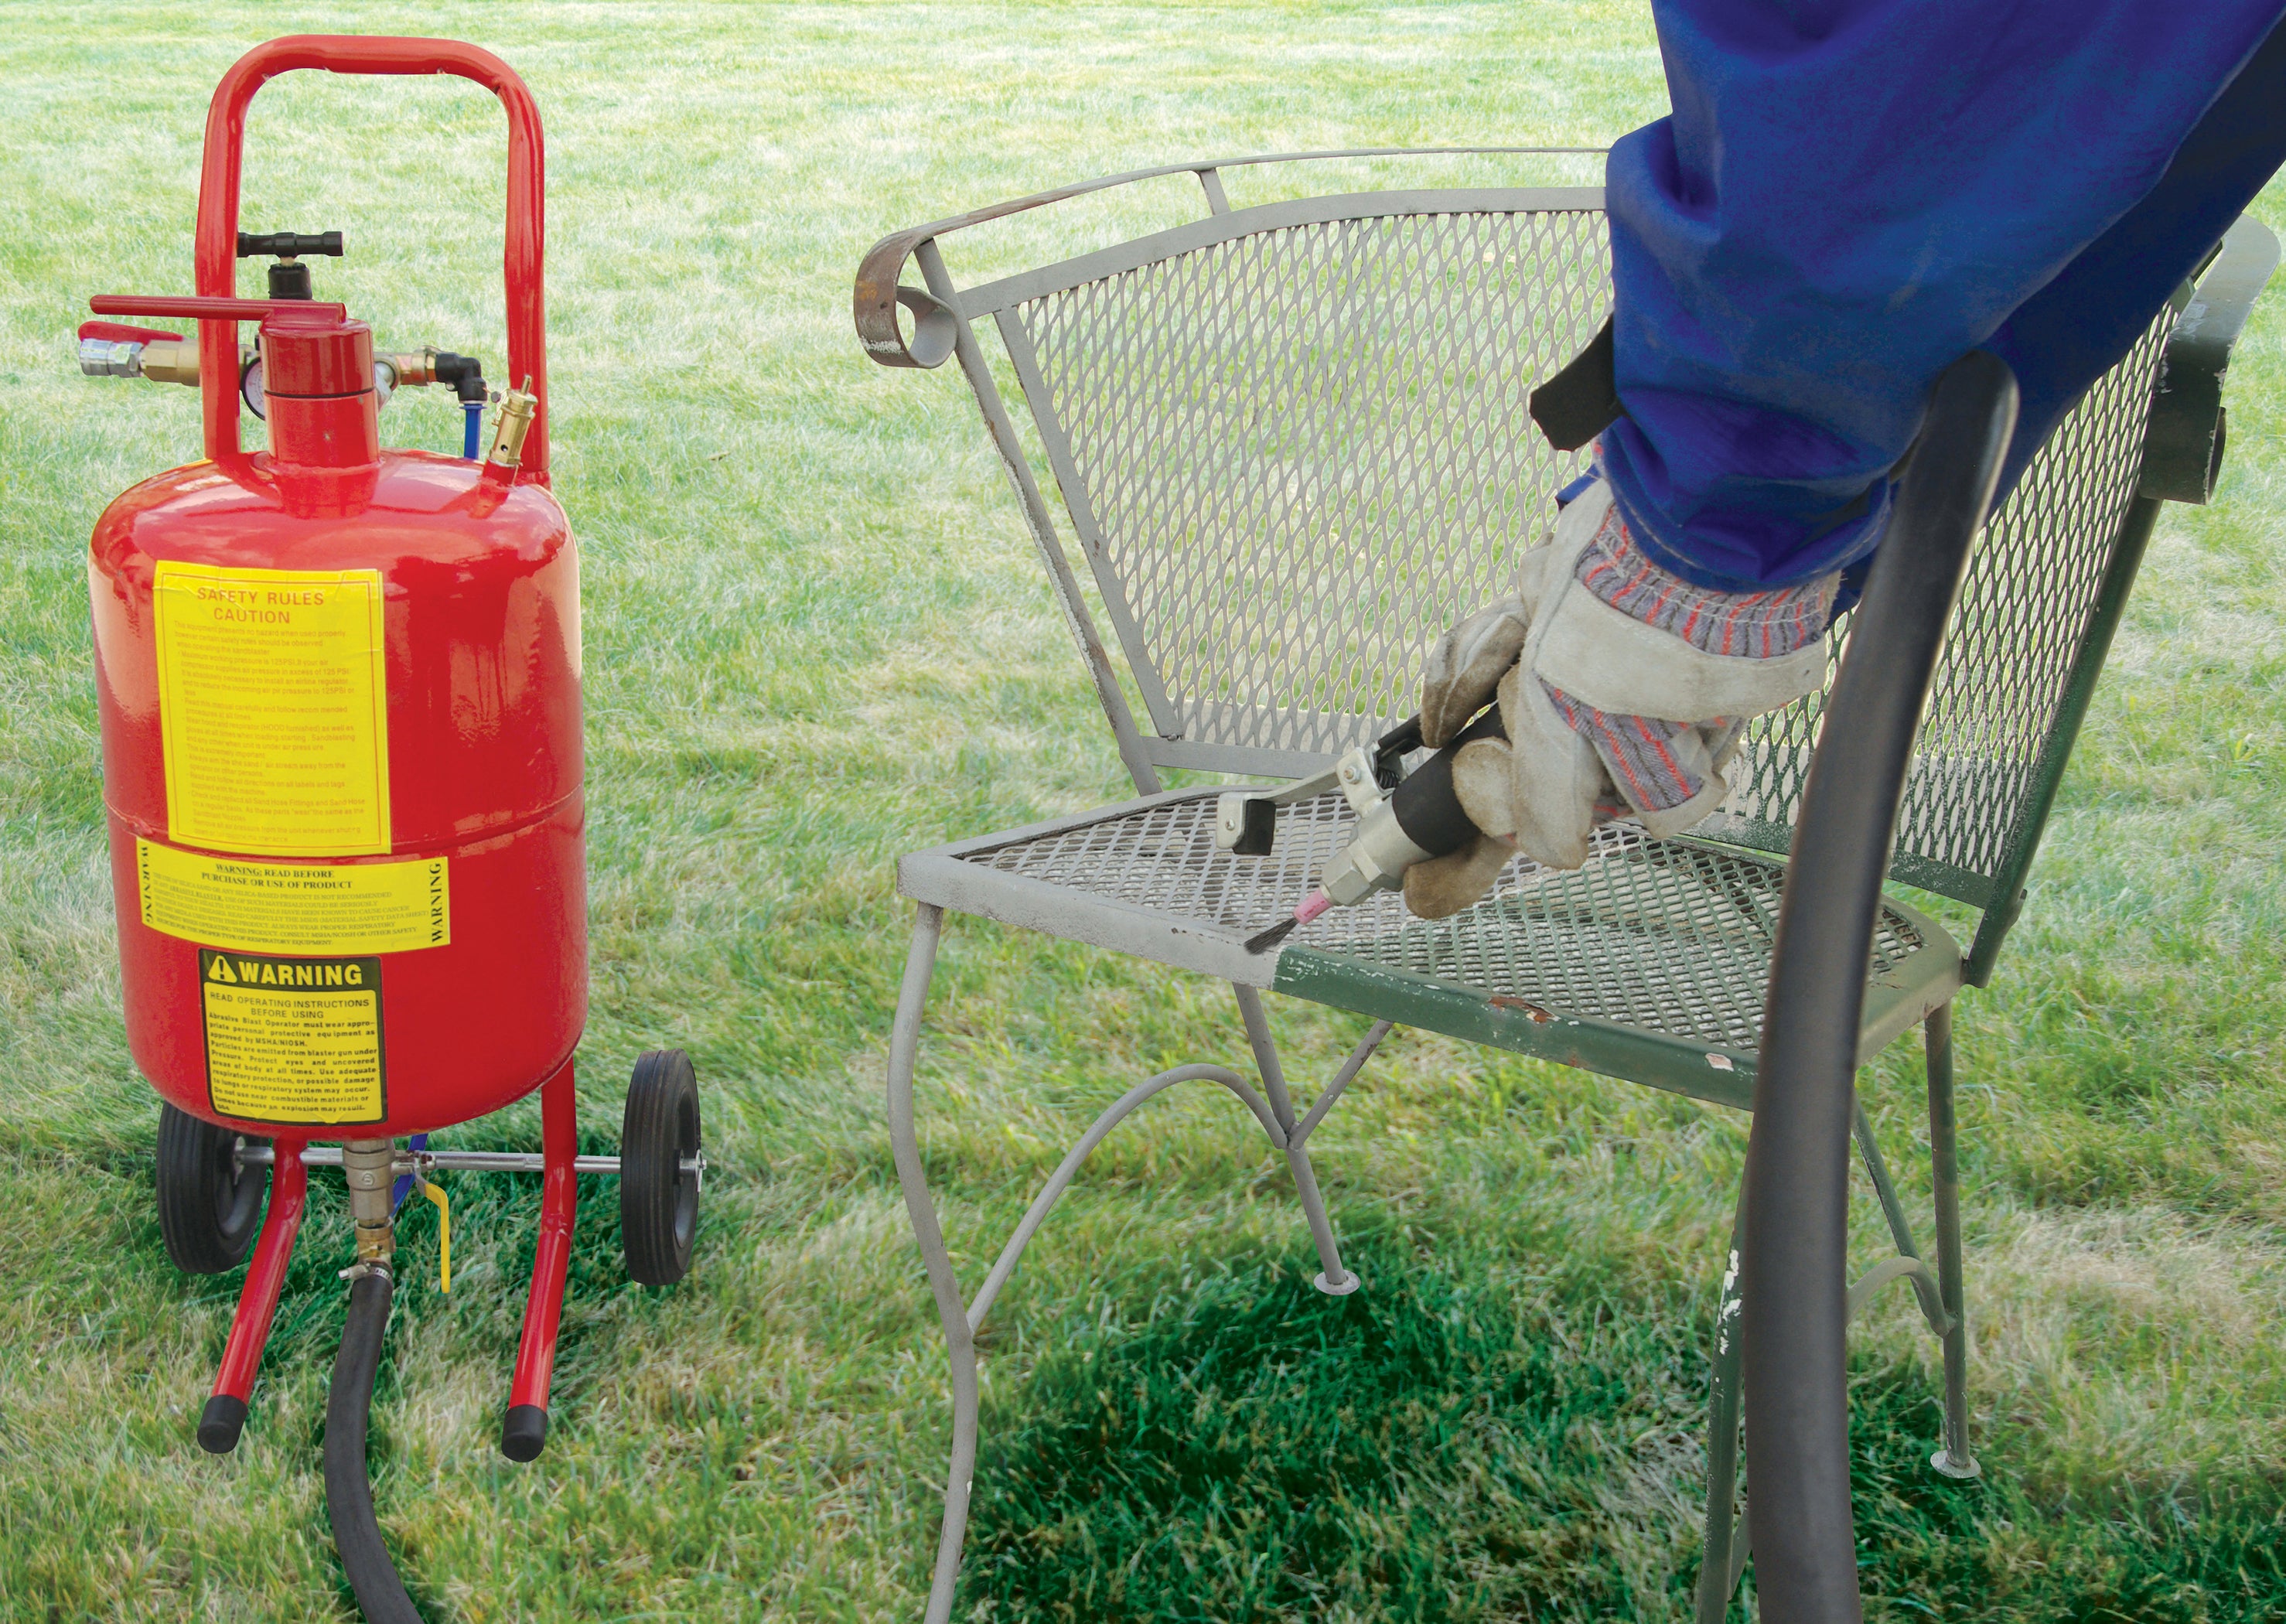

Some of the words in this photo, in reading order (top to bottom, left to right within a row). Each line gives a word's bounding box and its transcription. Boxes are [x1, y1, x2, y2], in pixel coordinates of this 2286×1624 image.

[197, 587, 258, 604] SAFETY
[268, 591, 324, 606] RULES
[214, 608, 290, 624] CAUTION
[216, 864, 262, 877] WARNING:
[264, 868, 291, 878] READ
[293, 870, 335, 879] BEFORE
[202, 872, 248, 886] PURCHASE
[251, 879, 264, 887] OR
[303, 881, 353, 889] PRODUCT
[429, 863, 443, 943] WARNING
[238, 961, 363, 986] WARNING
[210, 991, 233, 1002] READ
[237, 996, 292, 1008] OPERATING
[294, 999, 370, 1008] INSTRUCTIONS
[209, 1012, 239, 1022] Abrasive
[242, 1017, 261, 1025] Blast
[265, 1019, 300, 1028] Operator
[347, 1021, 375, 1029] appro-
[251, 1008, 287, 1018] BEFORE
[210, 1032, 242, 1042] approved
[211, 1040, 241, 1051] Particles
[249, 1056, 278, 1064] Protect
[213, 1069, 251, 1081] respiratory
[244, 1064, 261, 1073] body
[339, 1067, 377, 1076] adequate
[221, 1078, 240, 1088] lungs
[251, 1084, 292, 1093] respiratory
[237, 1100, 267, 1109] because
[281, 1104, 319, 1113] explosion
